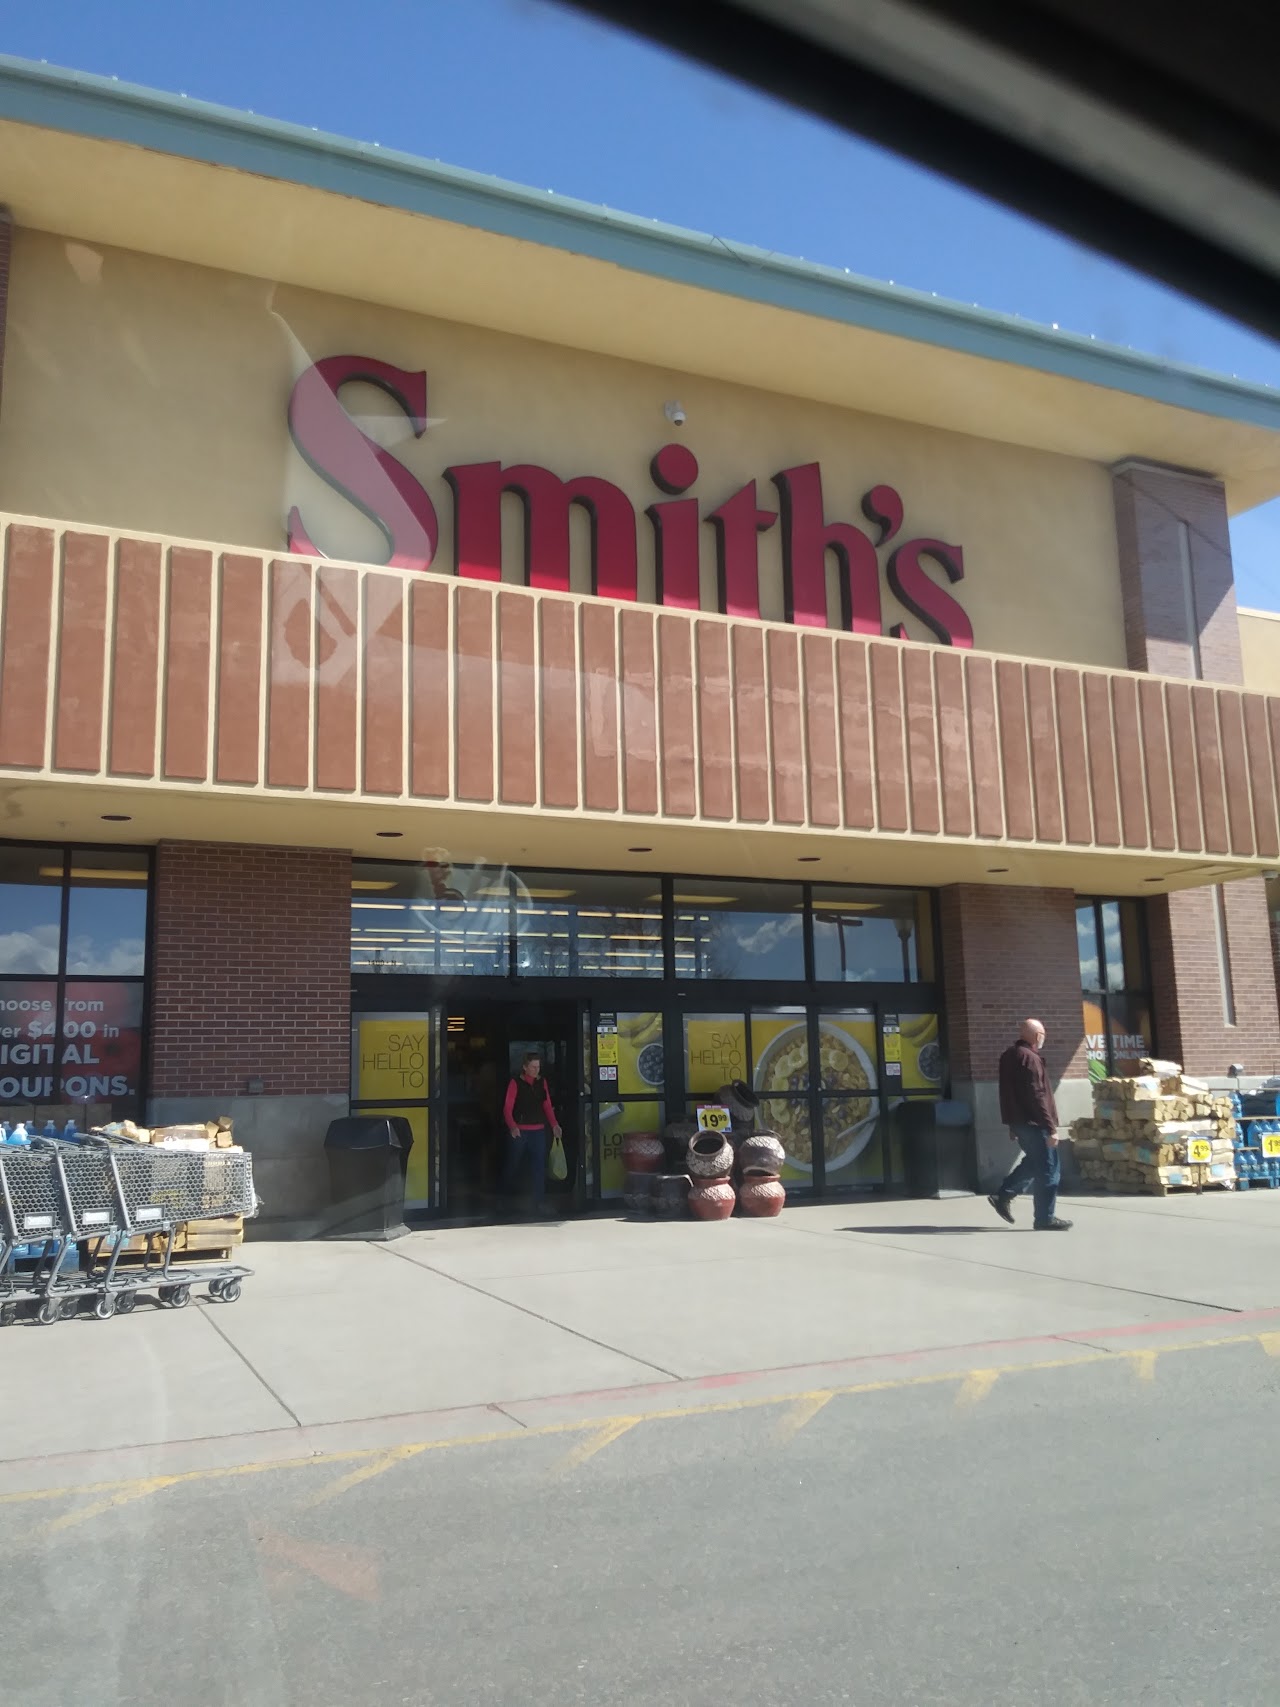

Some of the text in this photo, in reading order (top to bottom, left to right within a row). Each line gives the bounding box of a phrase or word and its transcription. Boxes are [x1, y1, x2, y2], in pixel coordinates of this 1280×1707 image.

[288, 355, 974, 648] Smith's
[28, 1020, 97, 1040] $400
[103, 1024, 119, 1037] in
[388, 1034, 425, 1051] SAY
[711, 1033, 742, 1049] SAY
[1112, 1034, 1145, 1049] TIME
[362, 1053, 425, 1070] HELLO
[690, 1049, 742, 1066] HELLO
[398, 1071, 425, 1088] TO
[720, 1066, 742, 1081] TO
